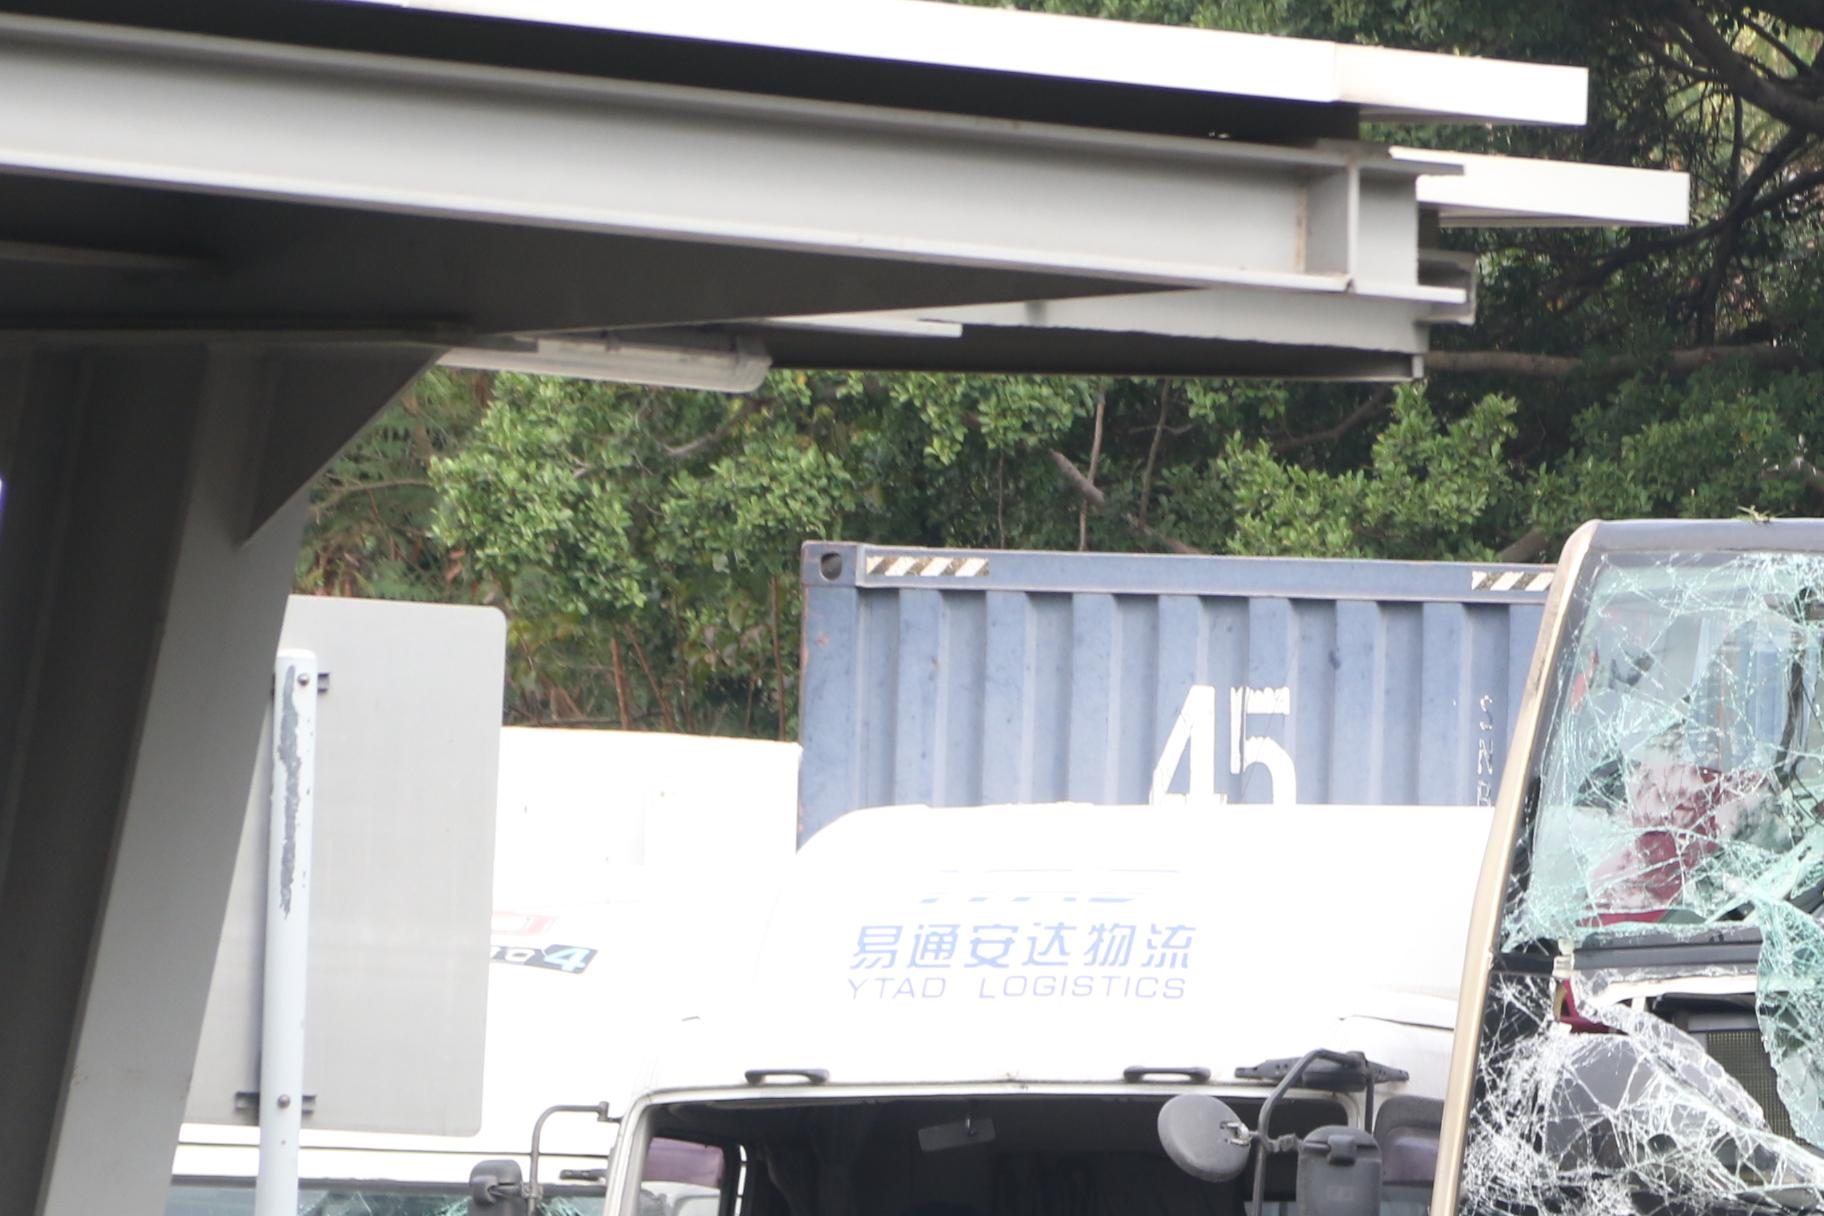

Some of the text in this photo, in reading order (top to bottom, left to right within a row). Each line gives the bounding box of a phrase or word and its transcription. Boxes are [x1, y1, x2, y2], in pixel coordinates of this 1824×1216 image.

[1150, 684, 1298, 806] 45
[850, 921, 1197, 970] 易通安达物流
[847, 975, 1186, 1000] YTAD LOGISTICS
